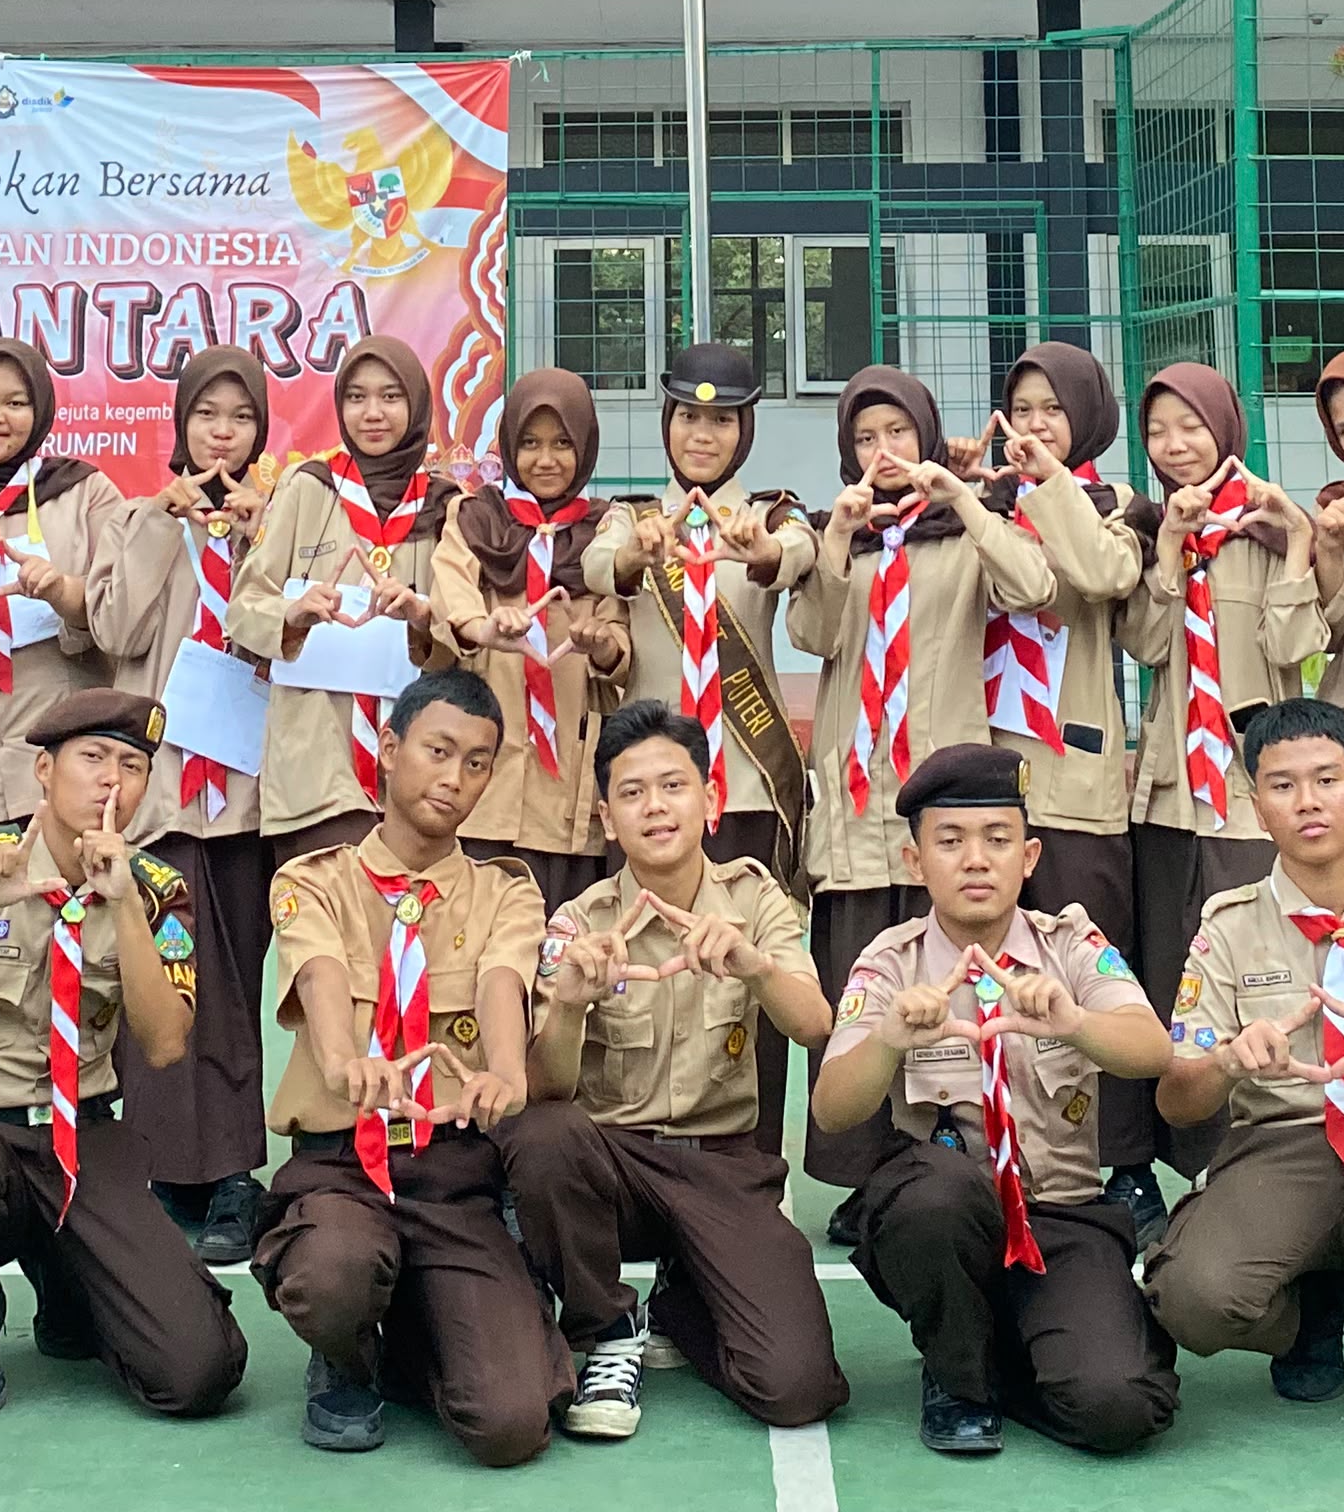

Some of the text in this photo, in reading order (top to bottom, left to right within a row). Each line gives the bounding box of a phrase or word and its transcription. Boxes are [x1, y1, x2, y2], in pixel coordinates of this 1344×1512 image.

[99, 160, 272, 198] Bersama
[63, 231, 301, 267] INDONESIA
[54, 402, 100, 426] ejuta
[40, 431, 138, 457] RUMPIN
